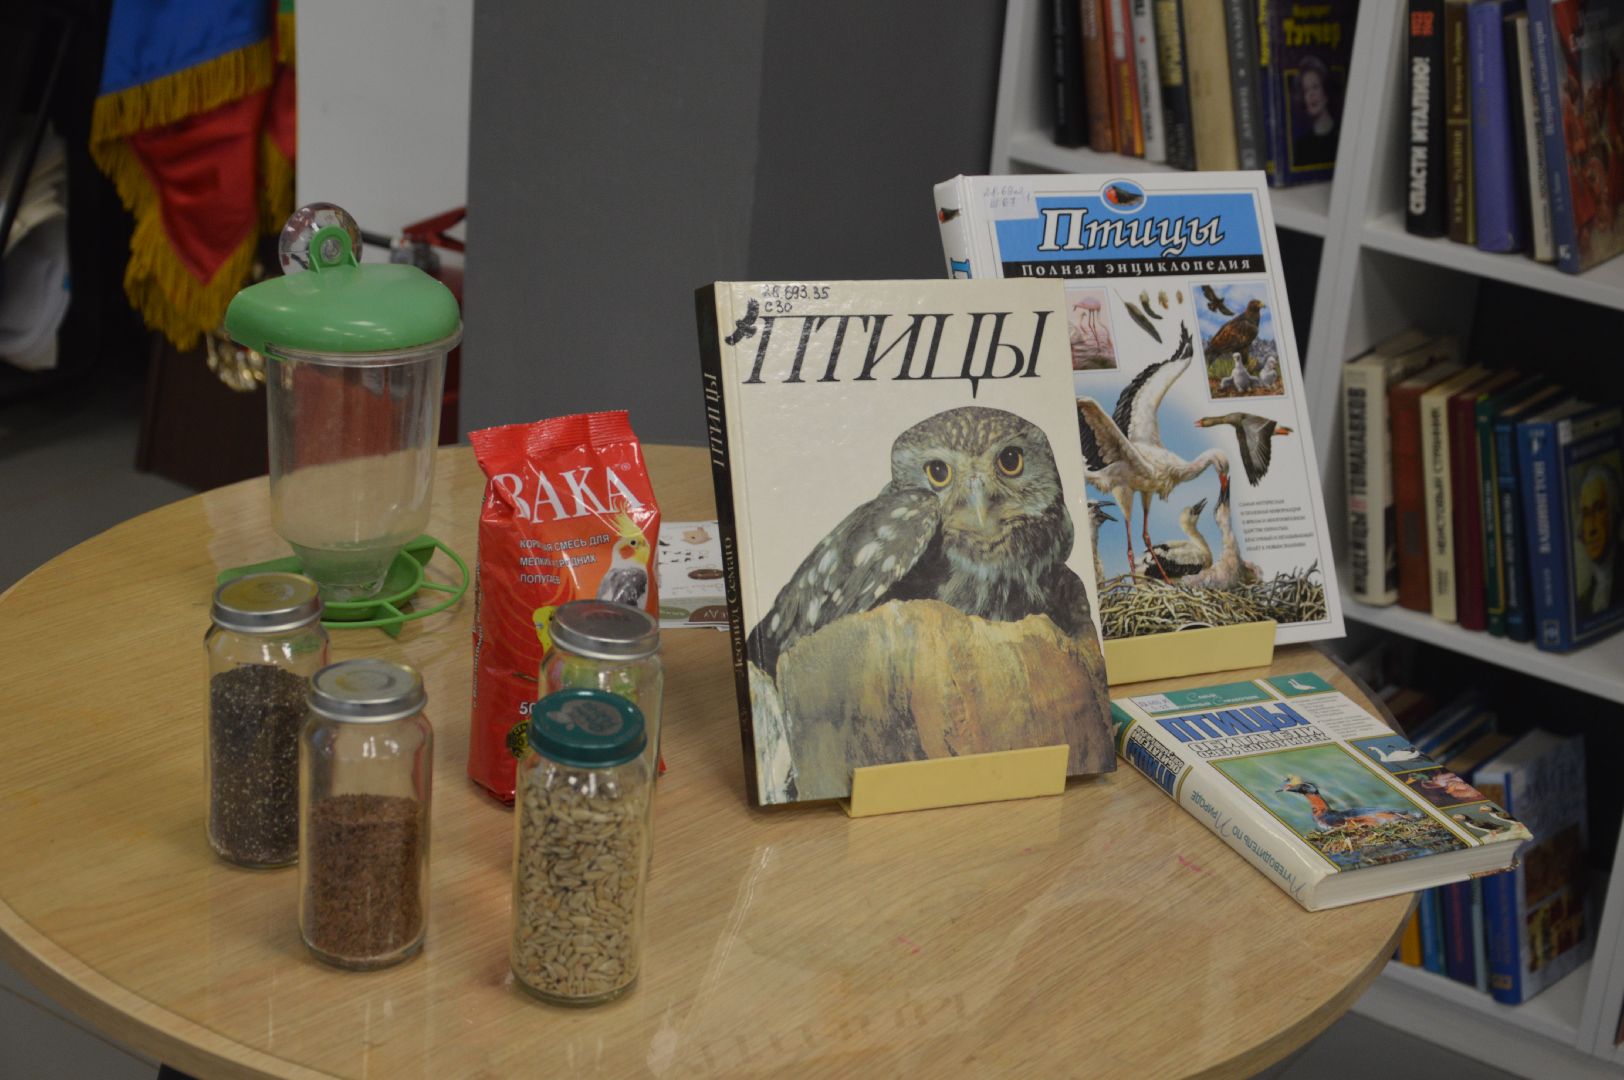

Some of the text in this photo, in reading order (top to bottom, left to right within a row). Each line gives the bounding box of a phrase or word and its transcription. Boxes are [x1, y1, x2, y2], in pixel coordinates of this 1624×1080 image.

[1411, 57, 1431, 143] ИТАЛИЮ!
[1409, 146, 1428, 216] СПАСТИ
[1037, 207, 1226, 258] Птицы
[1022, 258, 1252, 278] Полная энциклопедия
[742, 310, 1055, 399] ПТИЦЫ
[703, 373, 725, 467] ПТИЦЫ
[554, 538, 587, 551] СМЕСЬ
[589, 534, 610, 546] ДЛЯ
[1155, 702, 1312, 744] ПТИЦЫ
[1187, 725, 1326, 752] ОБИТАТЕЛИ
[1190, 790, 1306, 902] ПУТЕВОДИТЕЛЬ ПО ПРИРОДЕ
